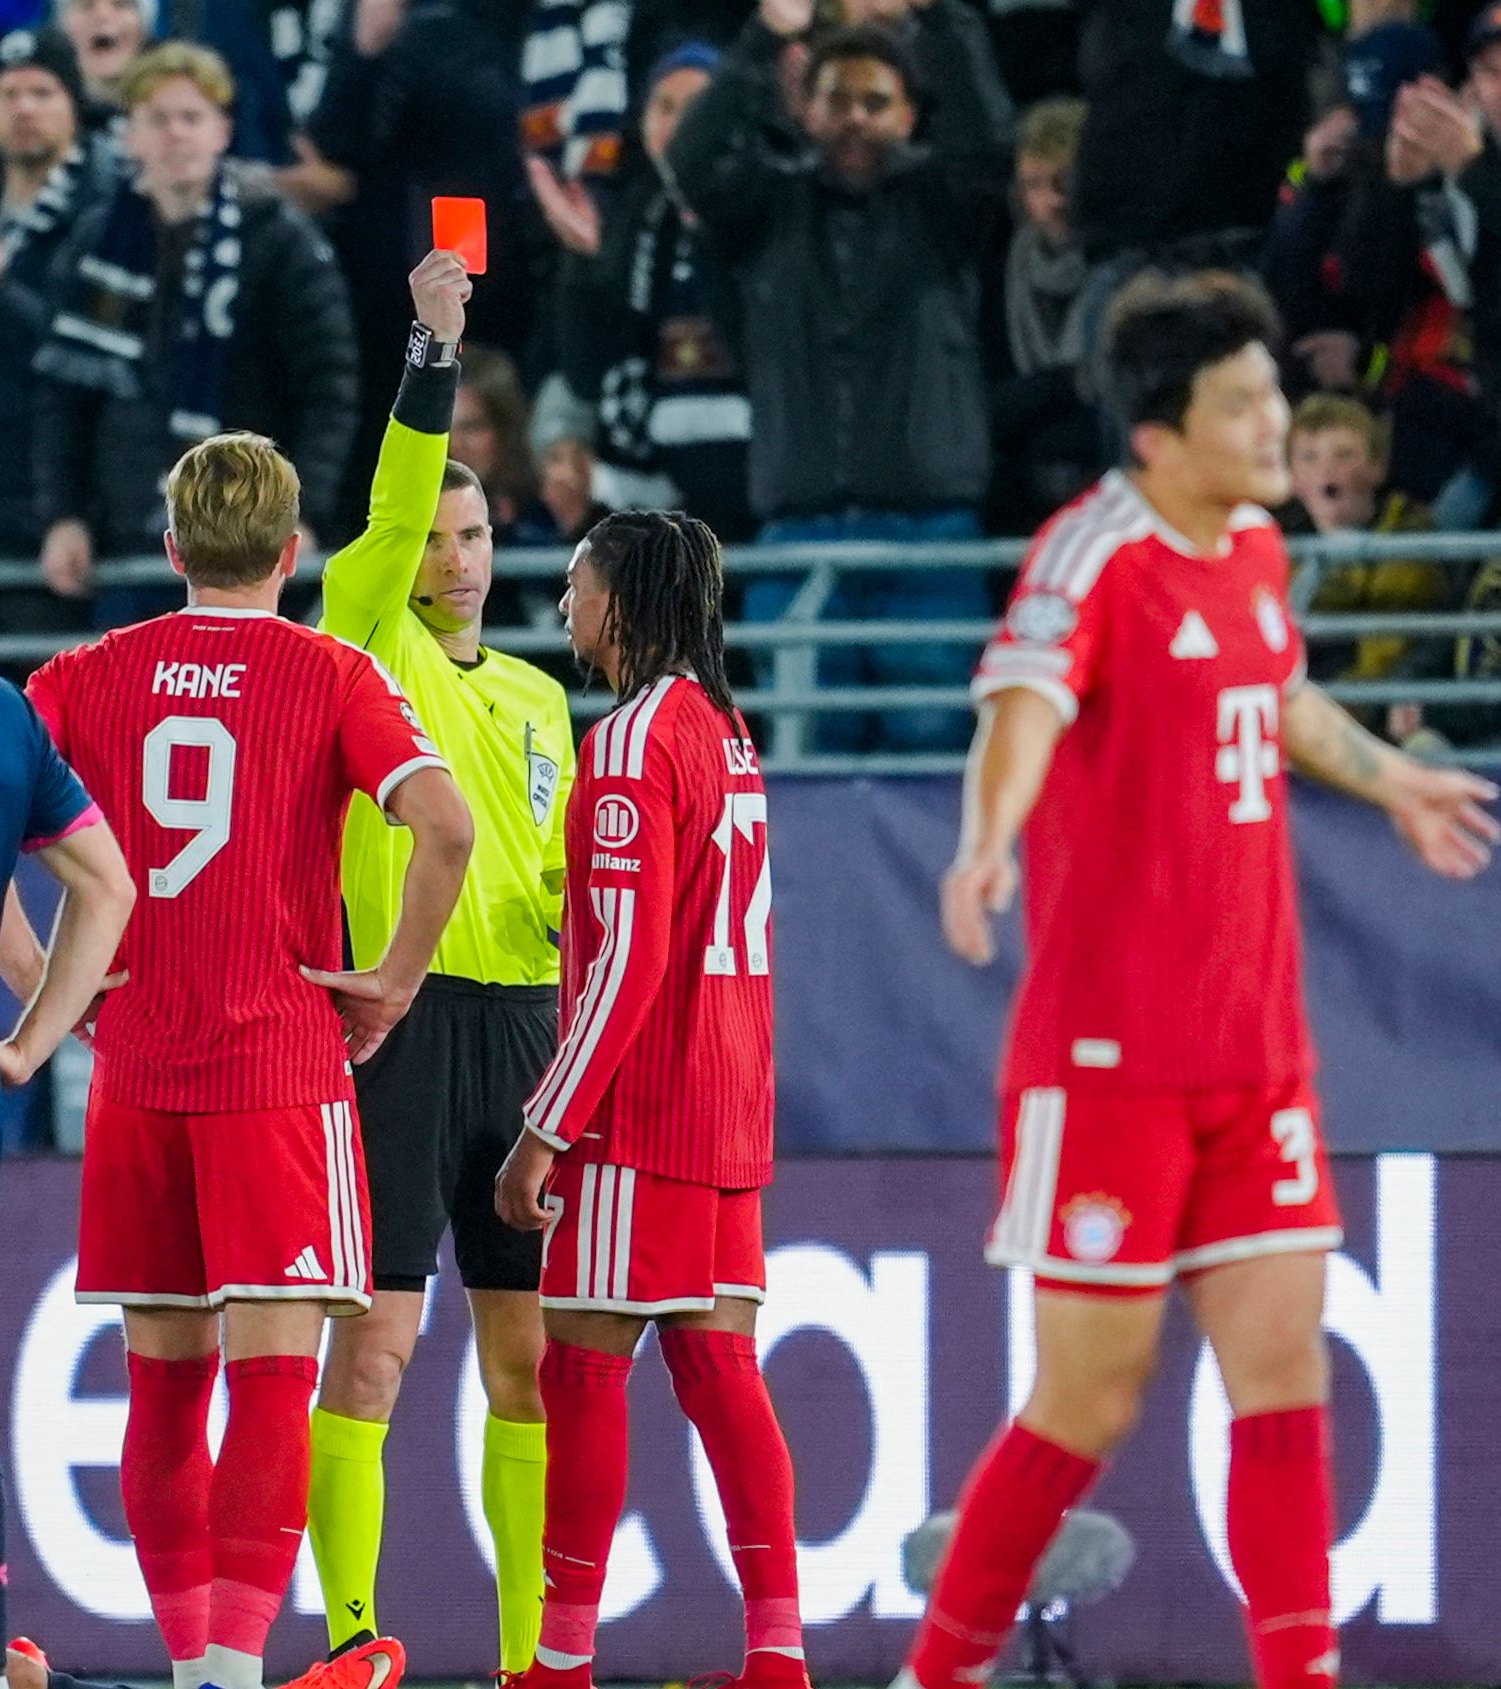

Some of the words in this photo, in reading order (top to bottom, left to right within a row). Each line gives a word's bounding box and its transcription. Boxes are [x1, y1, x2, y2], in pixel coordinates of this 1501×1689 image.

[151, 661, 247, 699] KANE
[142, 715, 237, 899] 9
[591, 852, 642, 873] llianz
[704, 792, 772, 976] 17
[1270, 1106, 1318, 1207] 3
